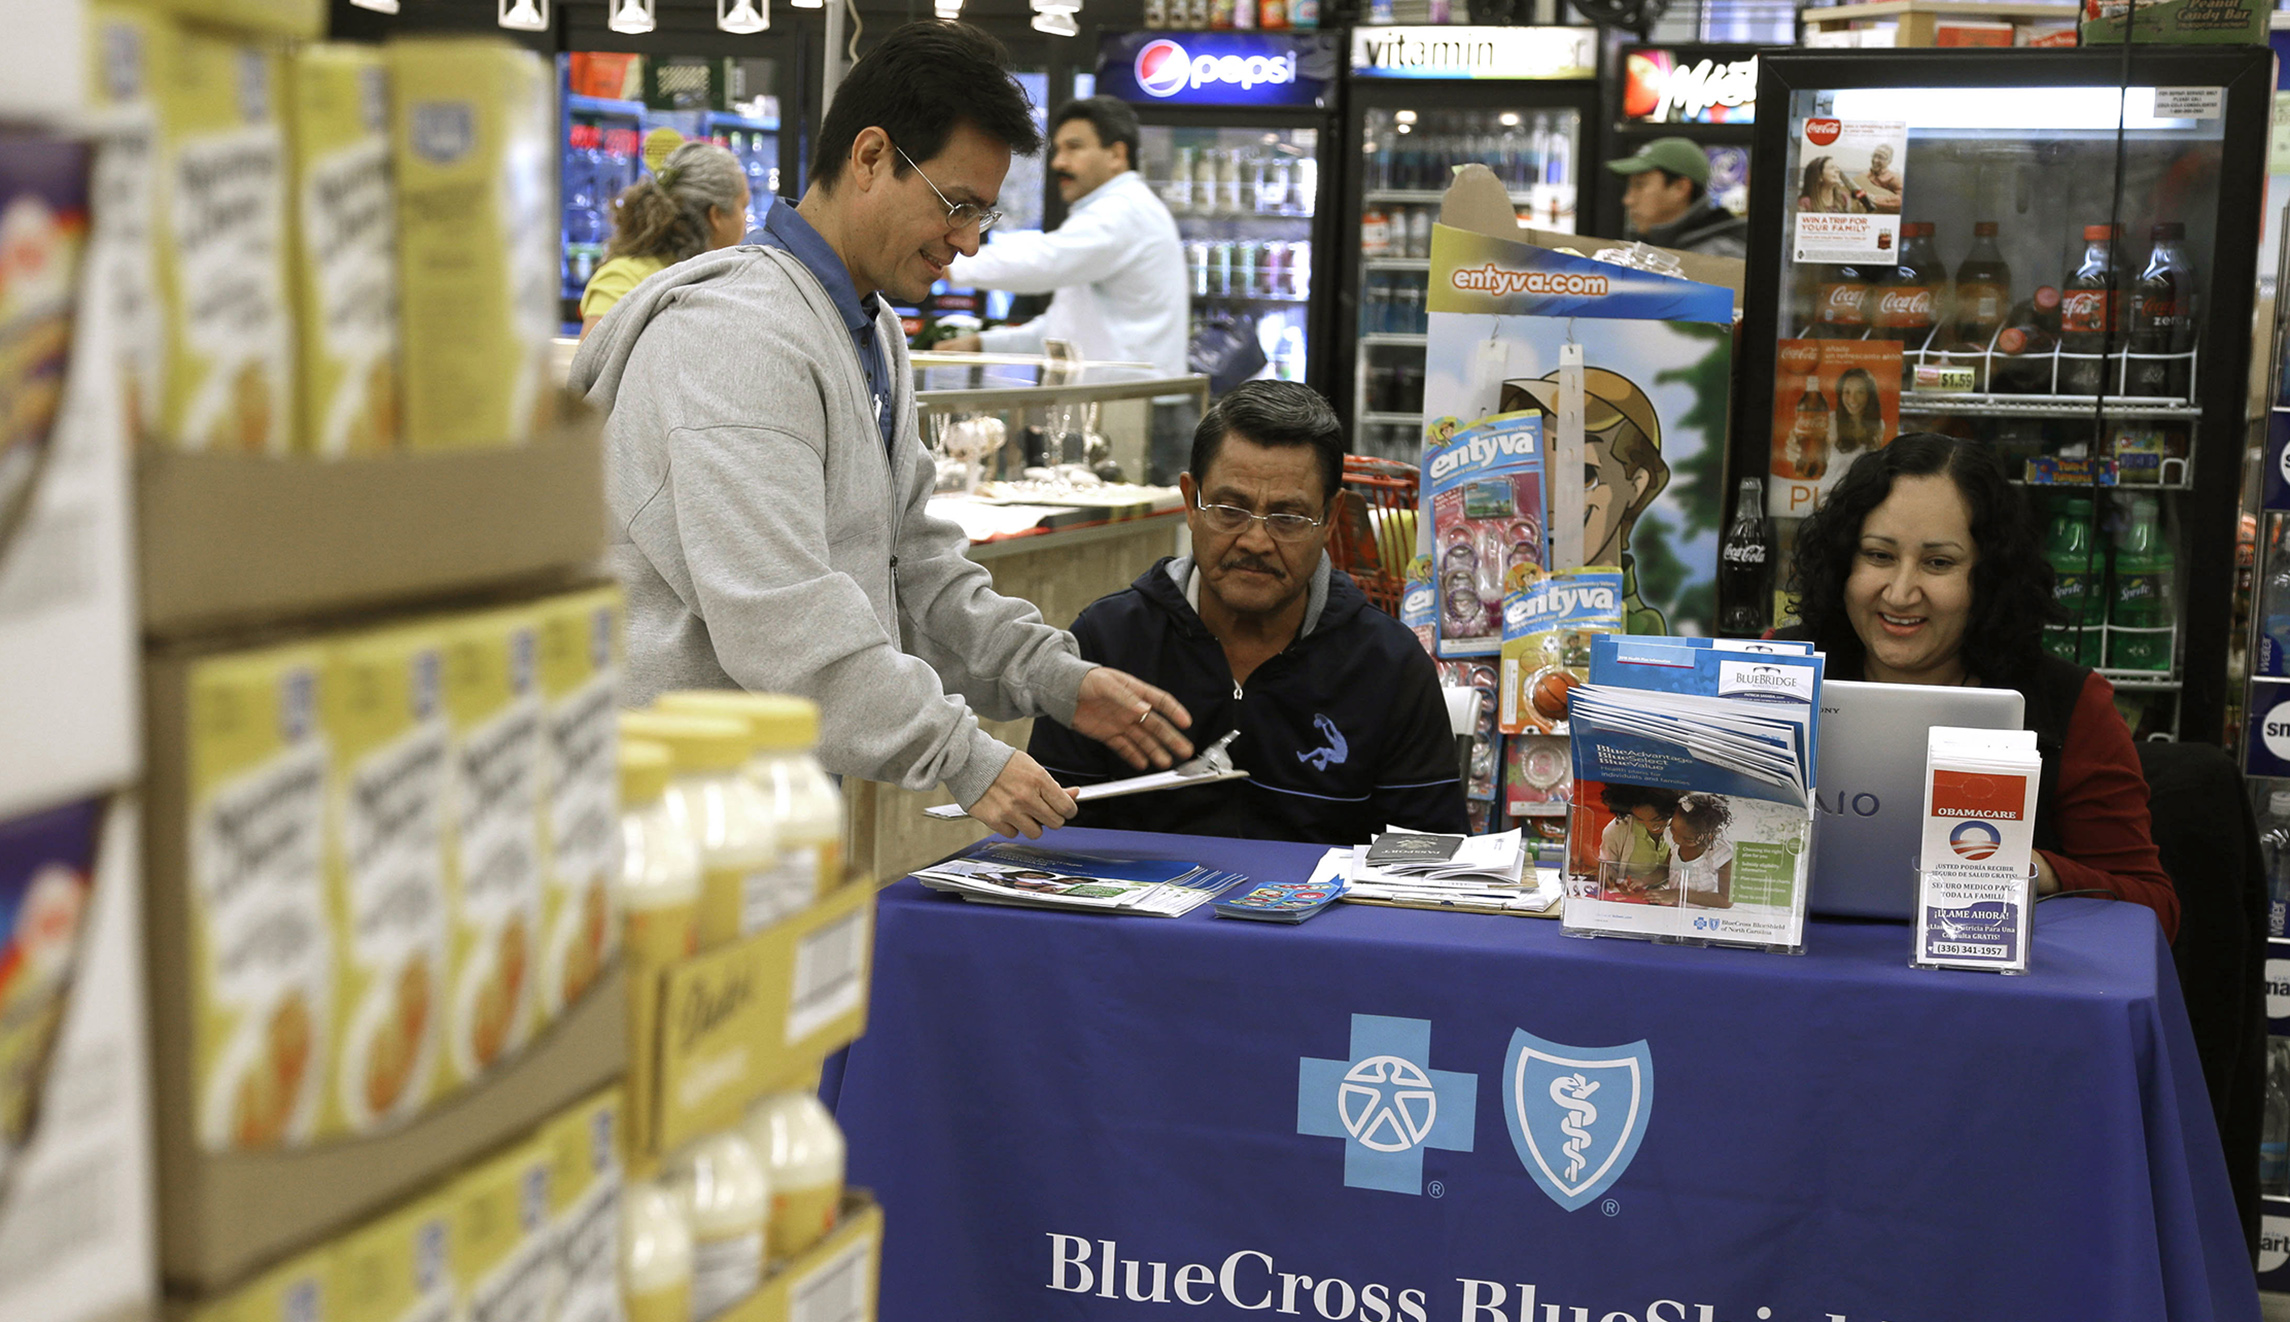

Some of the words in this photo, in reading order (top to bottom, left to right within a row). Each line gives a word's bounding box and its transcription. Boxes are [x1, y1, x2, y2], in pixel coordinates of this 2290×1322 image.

[2226, 9, 2249, 20] Bar
[1190, 50, 1297, 90] pepsi
[1821, 216, 1829, 224] A
[1829, 216, 1847, 225] TRIP
[1849, 217, 1868, 225] FOR
[1801, 224, 1829, 232] YOUR
[1452, 262, 1608, 297] entyva.com
[2153, 315, 2184, 327] zero
[1941, 374, 1973, 388] $1.59
[1430, 432, 1535, 479] entyva
[2053, 583, 2083, 598] Sprite
[2121, 584, 2150, 600] Sprite
[1506, 586, 1614, 624] entyva
[1596, 744, 1693, 764] BlueAdvantage
[1598, 752, 1669, 766] BlueSelect
[1601, 772, 1642, 780] individuals
[1938, 807, 2016, 819] OBAMACARE
[1963, 883, 1994, 891] MEDICO
[1971, 911, 2009, 920] AHORA!
[1937, 944, 1960, 954] (336)
[1961, 945, 2002, 955] 341-1957
[1046, 1232, 1428, 1322] BlueCross
